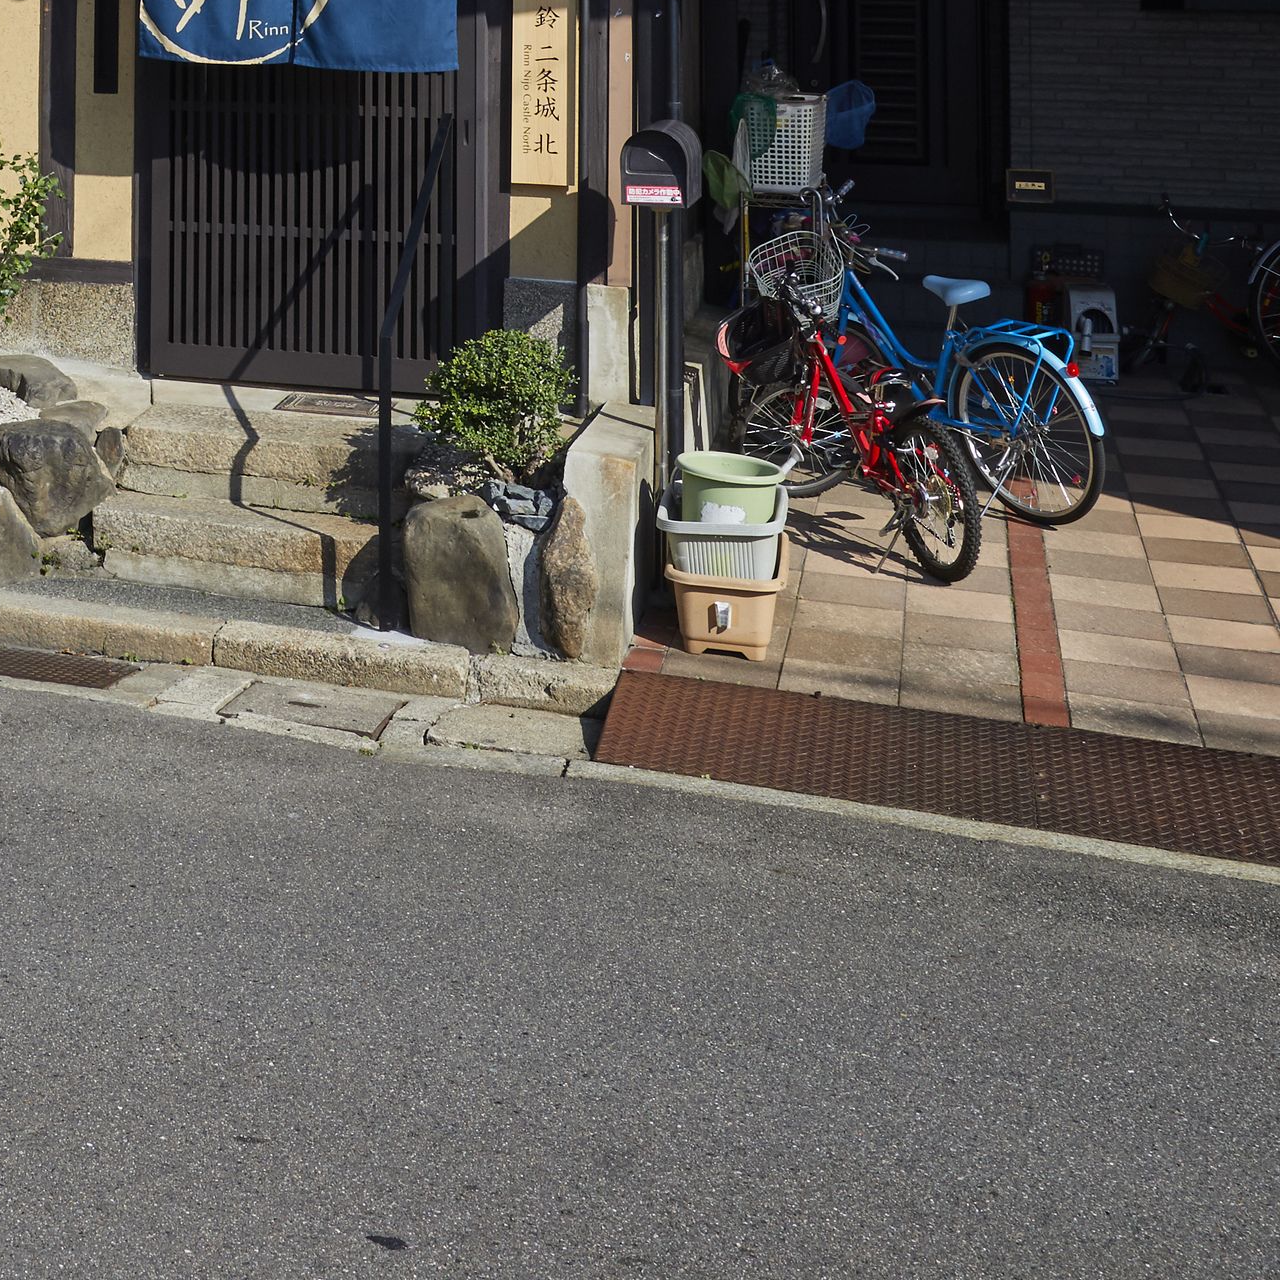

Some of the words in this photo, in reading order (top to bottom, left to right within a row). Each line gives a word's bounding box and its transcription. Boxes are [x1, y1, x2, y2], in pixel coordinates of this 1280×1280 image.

[249, 20, 289, 39] Rinn
[523, 44, 532, 66] Rinn
[521, 70, 532, 90] Nijo
[523, 94, 532, 123] Castle
[523, 127, 532, 154] North
